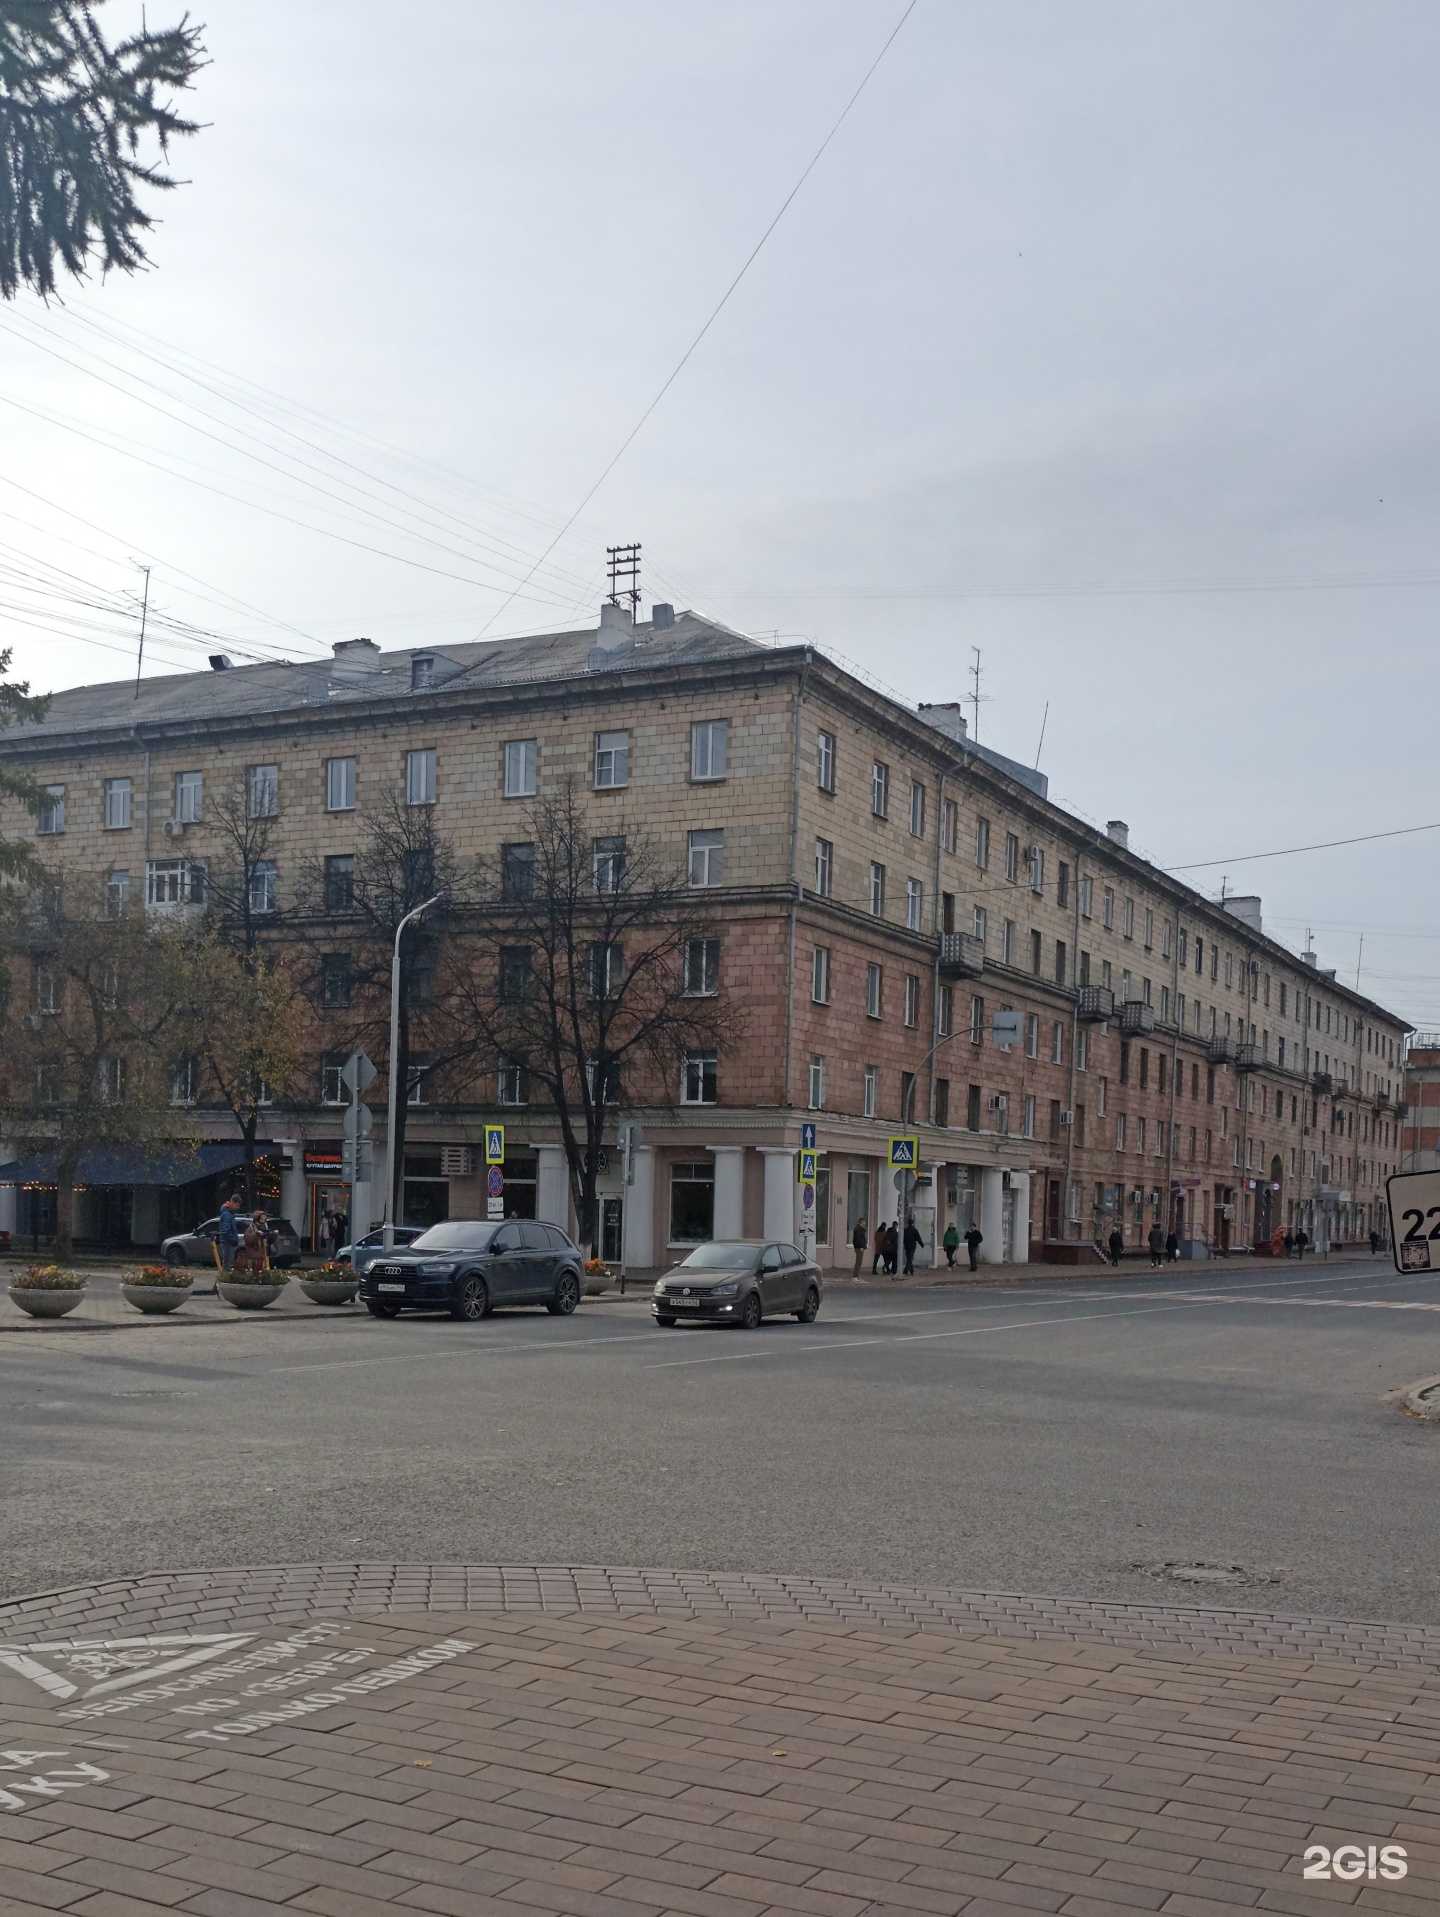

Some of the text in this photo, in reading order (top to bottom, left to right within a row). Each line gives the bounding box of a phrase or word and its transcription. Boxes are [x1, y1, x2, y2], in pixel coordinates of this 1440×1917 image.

[171, 1698, 241, 1716] ПО
[183, 1638, 480, 1742] ТОЛЬКО ПЕШКОМ
